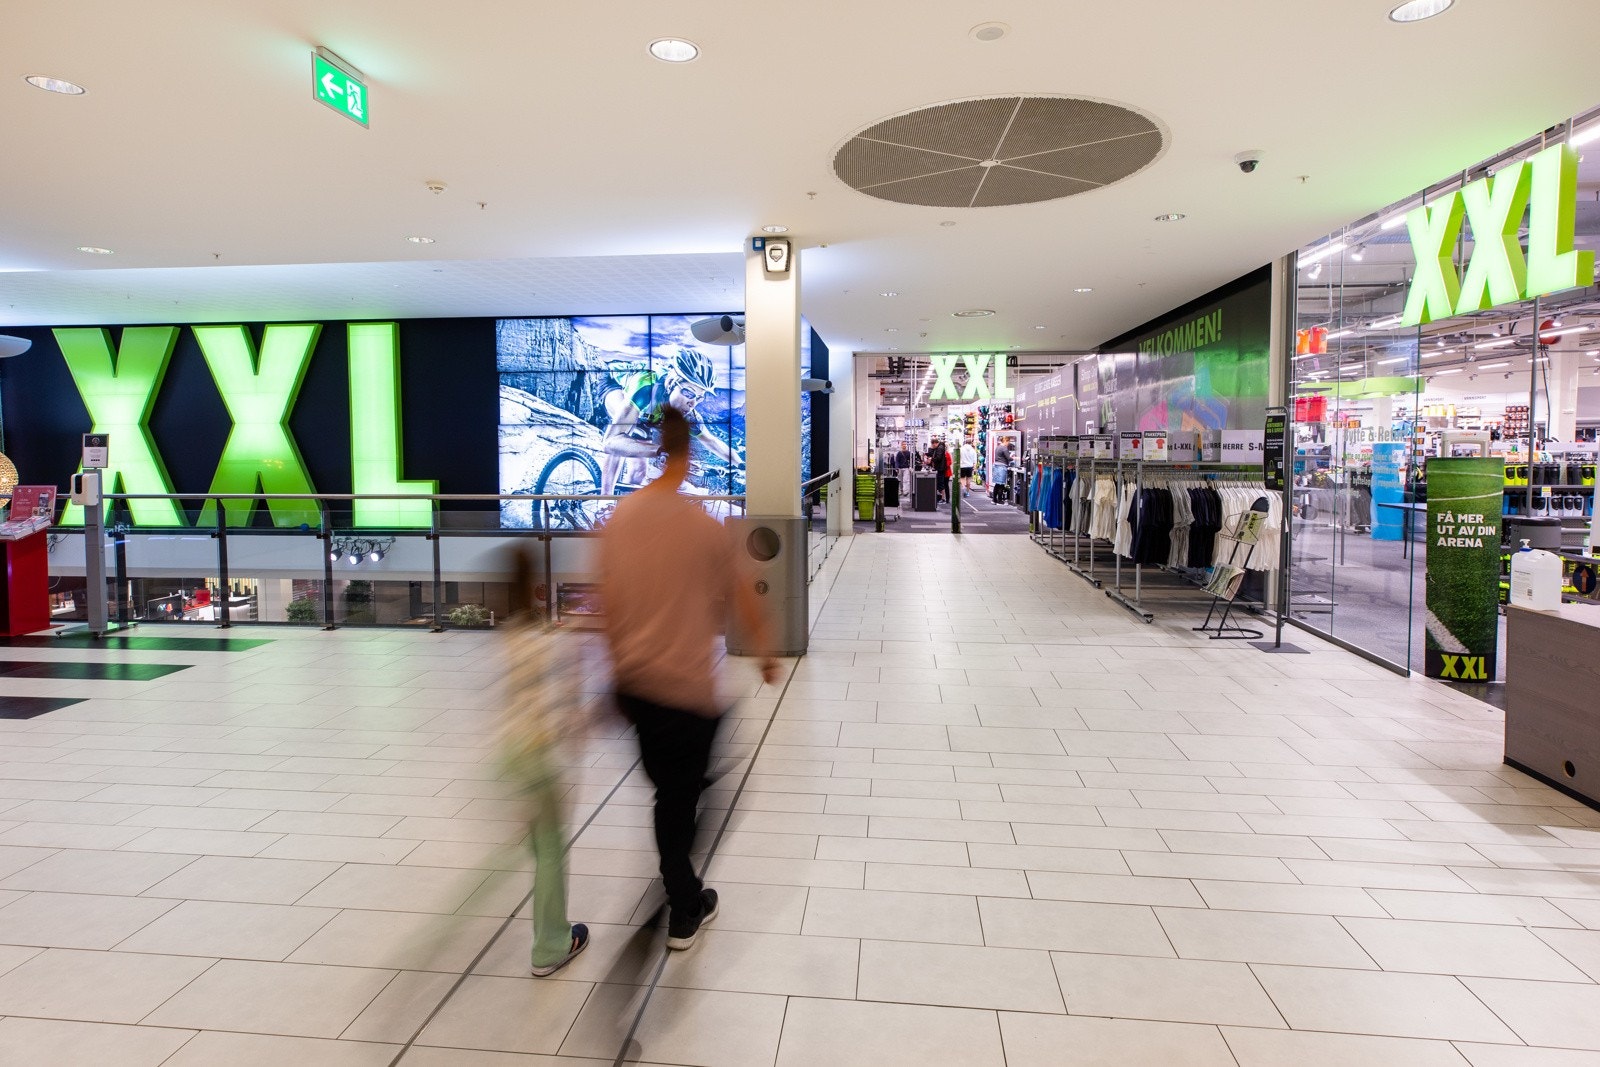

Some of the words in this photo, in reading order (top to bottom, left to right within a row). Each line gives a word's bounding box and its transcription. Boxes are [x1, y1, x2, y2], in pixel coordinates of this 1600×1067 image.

[1401, 143, 1595, 327] XXL
[1139, 308, 1222, 362] VELKOMMEN!
[929, 354, 1015, 400] XXL
[52, 322, 440, 527] XXL
[1437, 511, 1454, 524] FÅ
[1457, 513, 1484, 524] MER
[1437, 525, 1456, 535] UT
[1458, 525, 1475, 535] AV
[1477, 525, 1496, 536] DIN
[1437, 537, 1484, 548] ARENA
[1440, 654, 1488, 680] XXL
